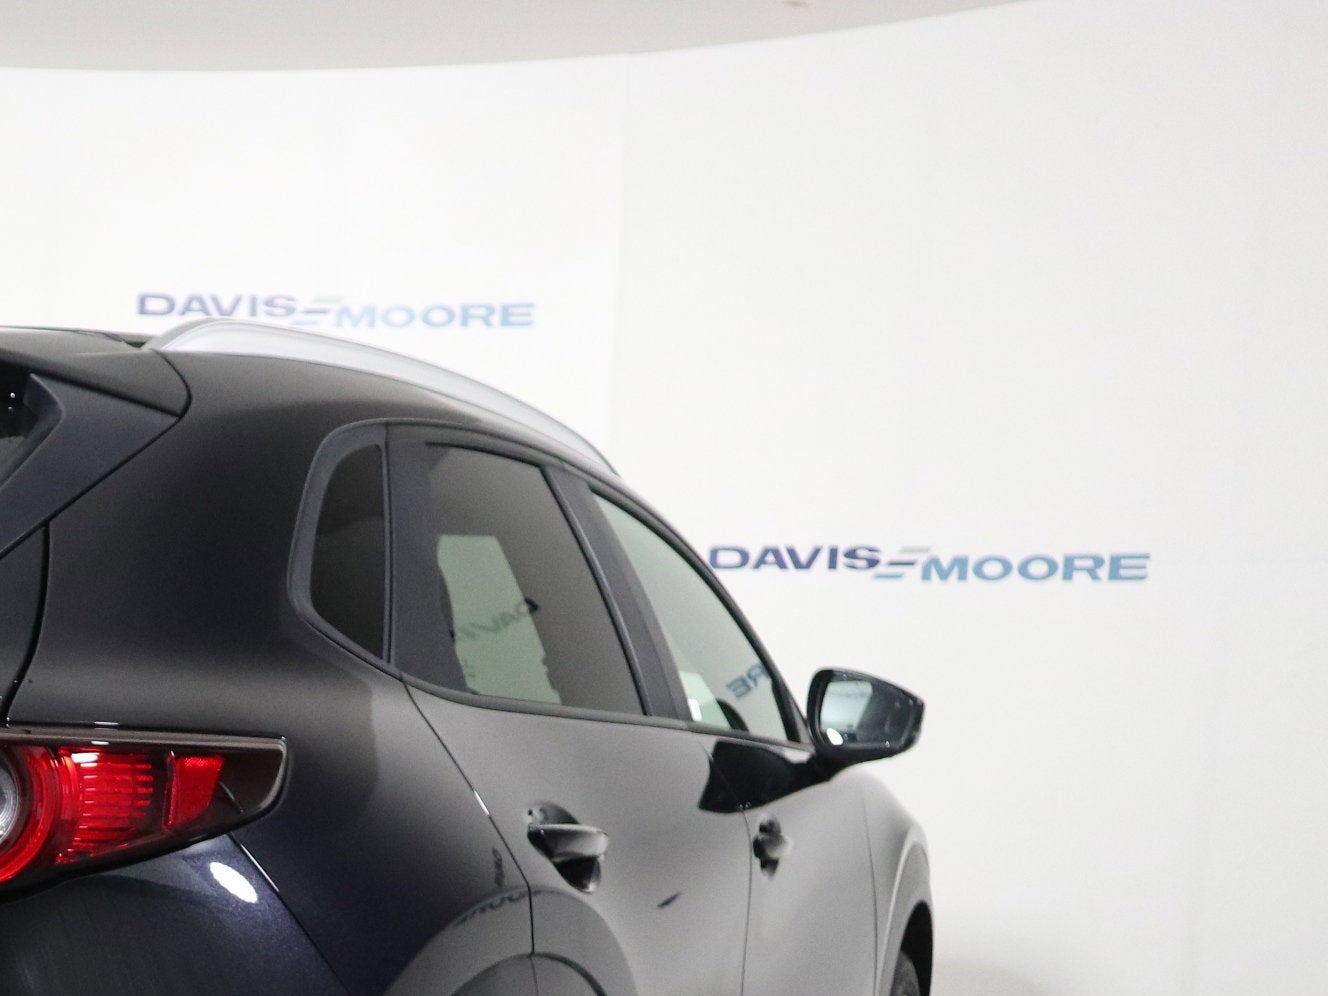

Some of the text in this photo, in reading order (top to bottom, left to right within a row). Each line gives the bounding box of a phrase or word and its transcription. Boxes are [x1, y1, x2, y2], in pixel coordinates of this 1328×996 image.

[136, 292, 536, 328] DAVIS MOORE
[708, 545, 1151, 582] DAVIS MOORE
